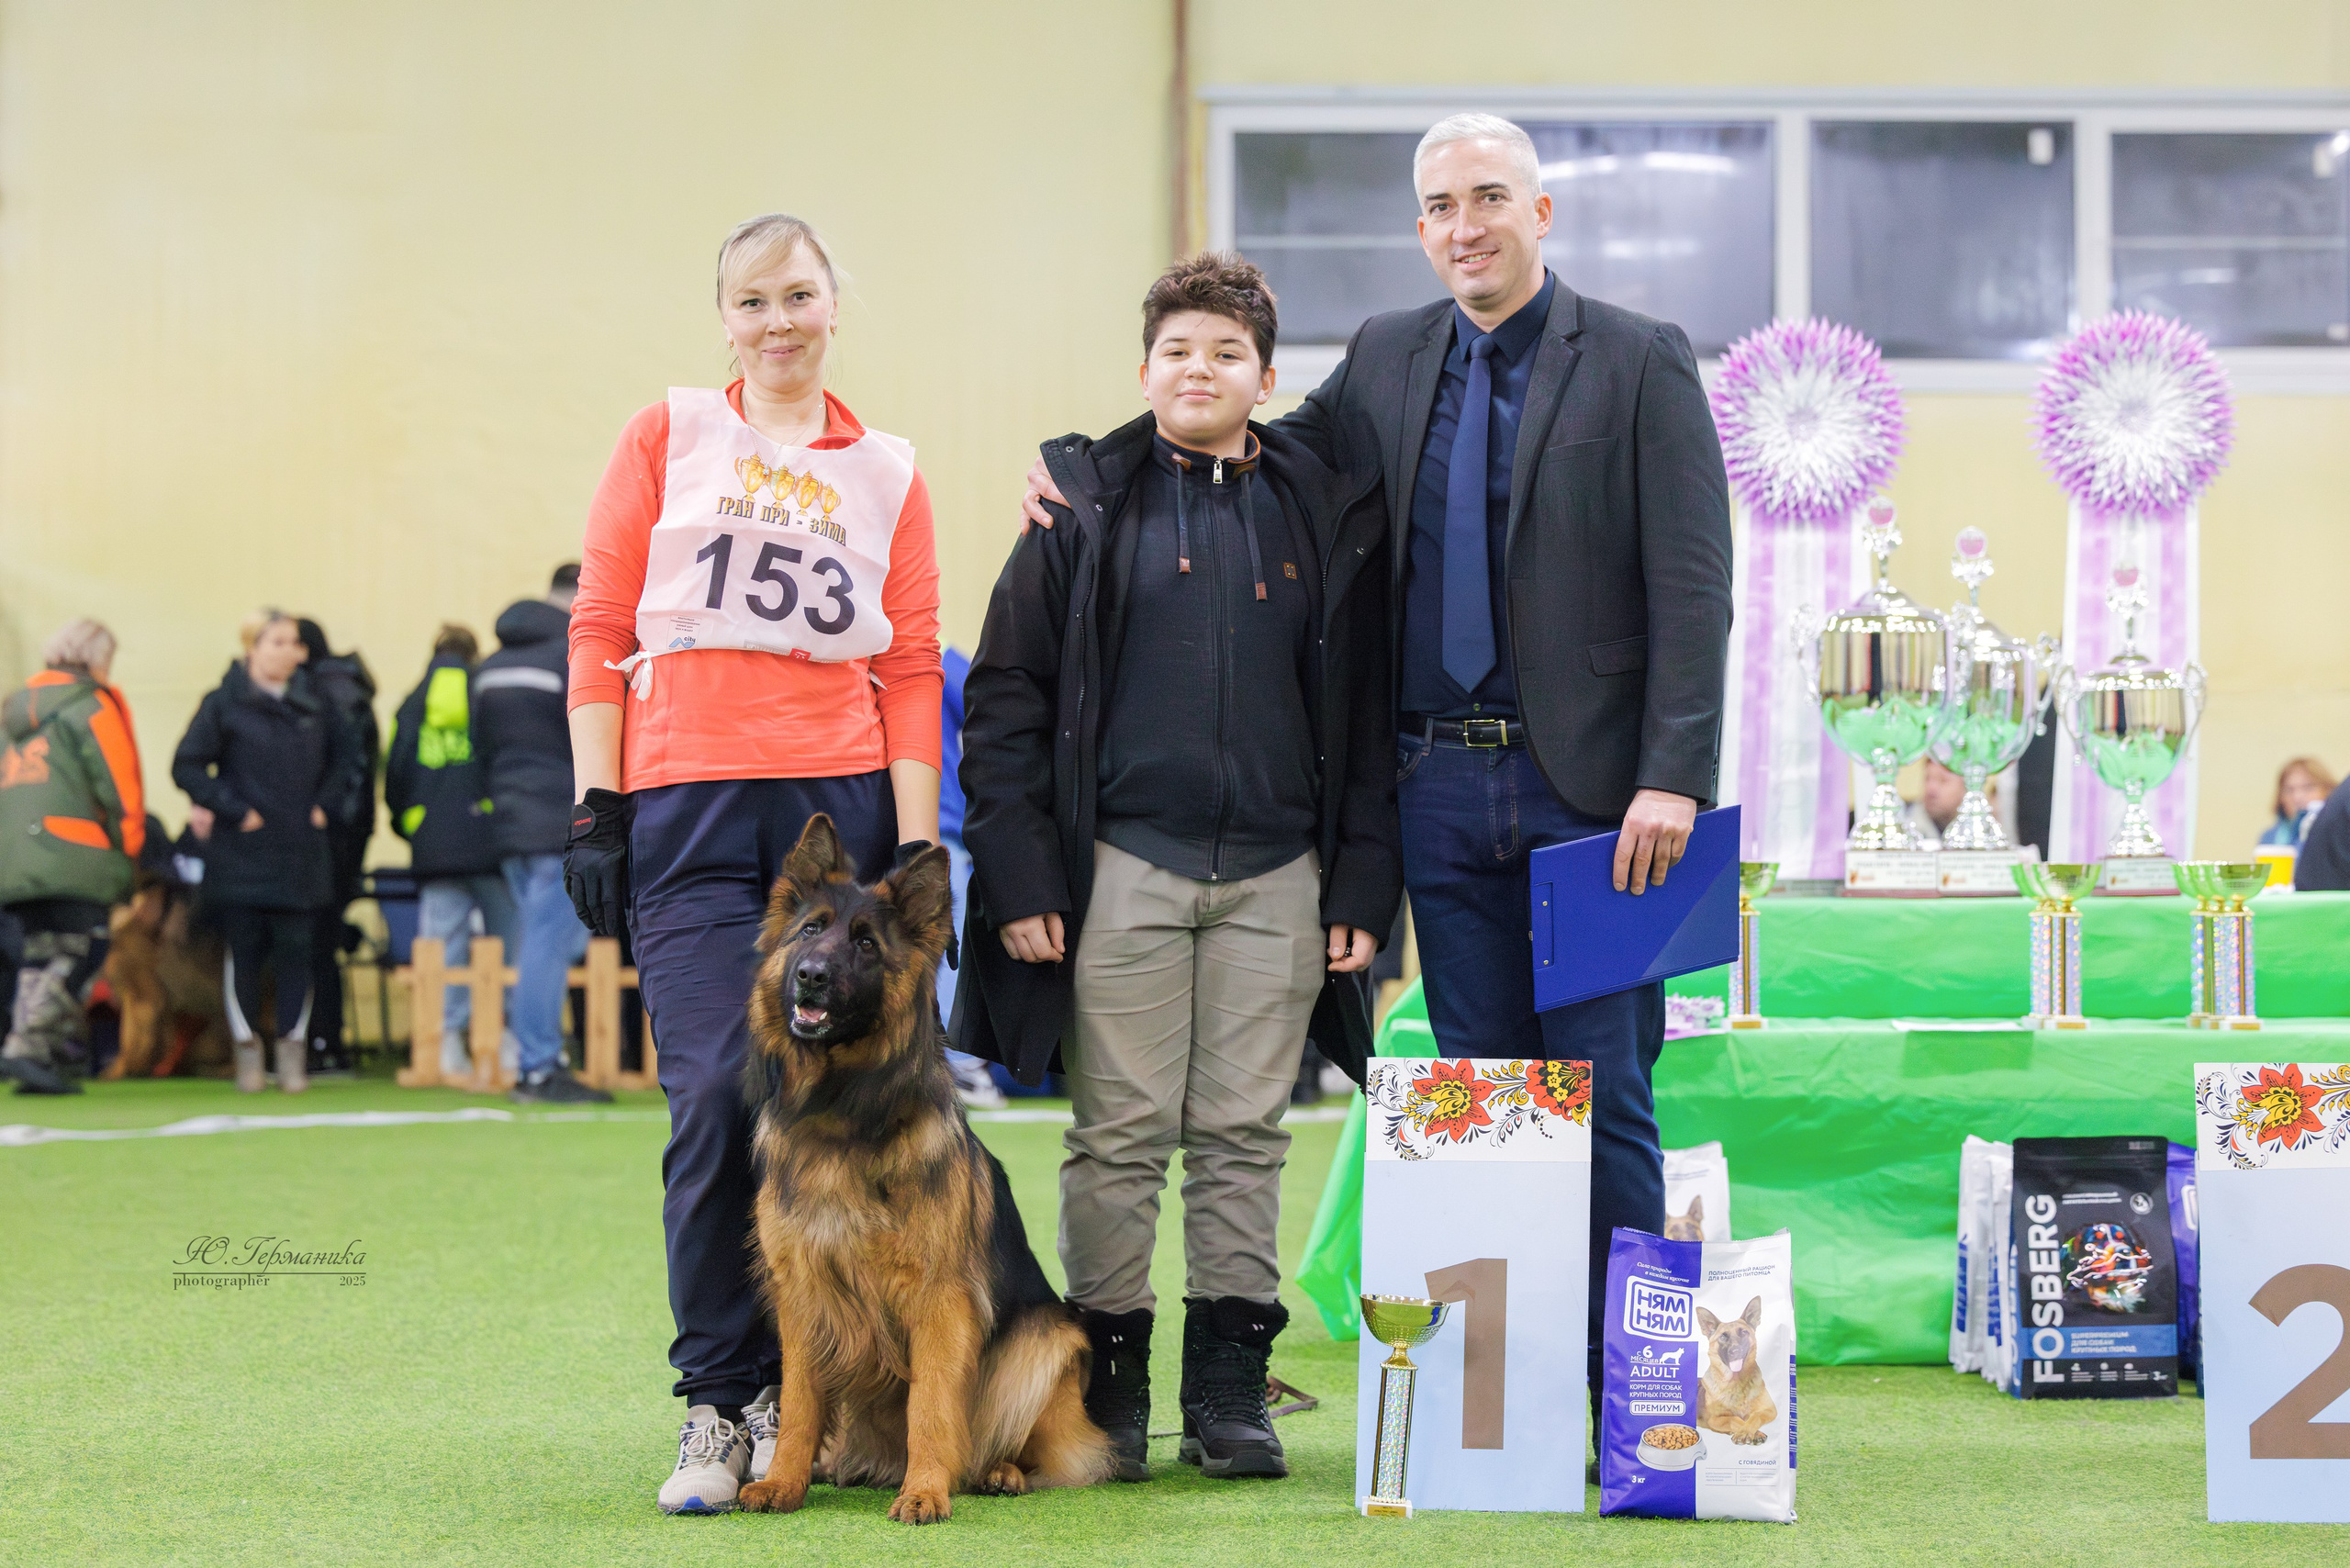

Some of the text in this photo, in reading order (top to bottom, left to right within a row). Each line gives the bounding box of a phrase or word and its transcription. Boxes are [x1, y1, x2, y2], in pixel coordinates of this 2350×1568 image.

[716, 497, 755, 519] ГРАН
[759, 505, 790, 526] ПРИ
[809, 518, 846, 546] ЗИМА
[696, 533, 856, 635] 153
[1637, 1261, 1651, 1270] Сила
[1708, 1267, 1751, 1276] ПОЛНОЦЕННЫЙ
[2025, 1194, 2065, 1383] FOSBERG
[1637, 1289, 1686, 1314] НЯМ
[1636, 1308, 1685, 1332] НЯМ
[1424, 1258, 1508, 1450] 1
[1630, 1355, 1659, 1363] МЕСЯЦЕВ
[1642, 1345, 1653, 1359] 6
[2247, 1263, 2350, 1460] 2
[1629, 1365, 1680, 1378] ADULT
[1634, 1404, 1681, 1412] ПРЕМИУМ
[1631, 1475, 1637, 1484] 3
